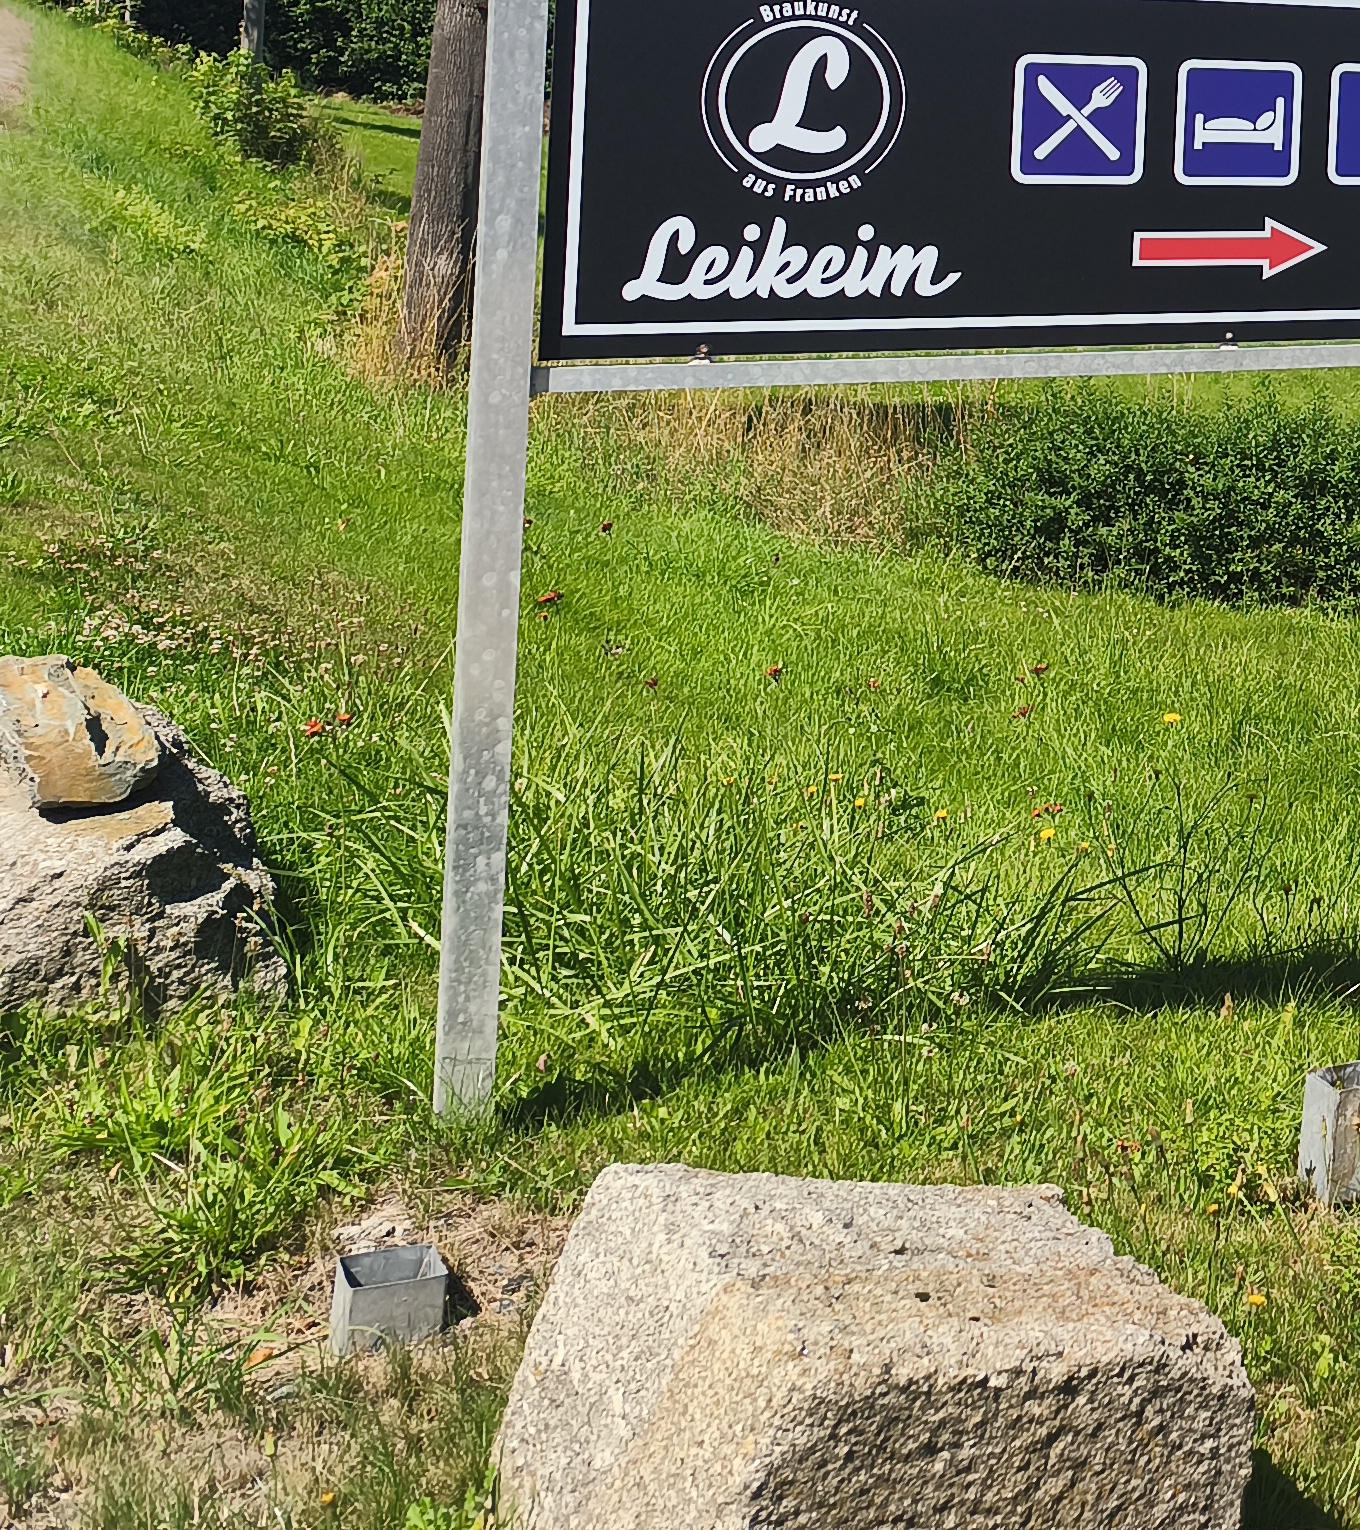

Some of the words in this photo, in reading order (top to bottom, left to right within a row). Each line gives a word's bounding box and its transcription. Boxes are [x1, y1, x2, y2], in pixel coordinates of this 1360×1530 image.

[748, 35, 850, 154] L
[743, 174, 776, 197] aus
[783, 174, 862, 203] Franken
[622, 215, 963, 302] Leikeim
